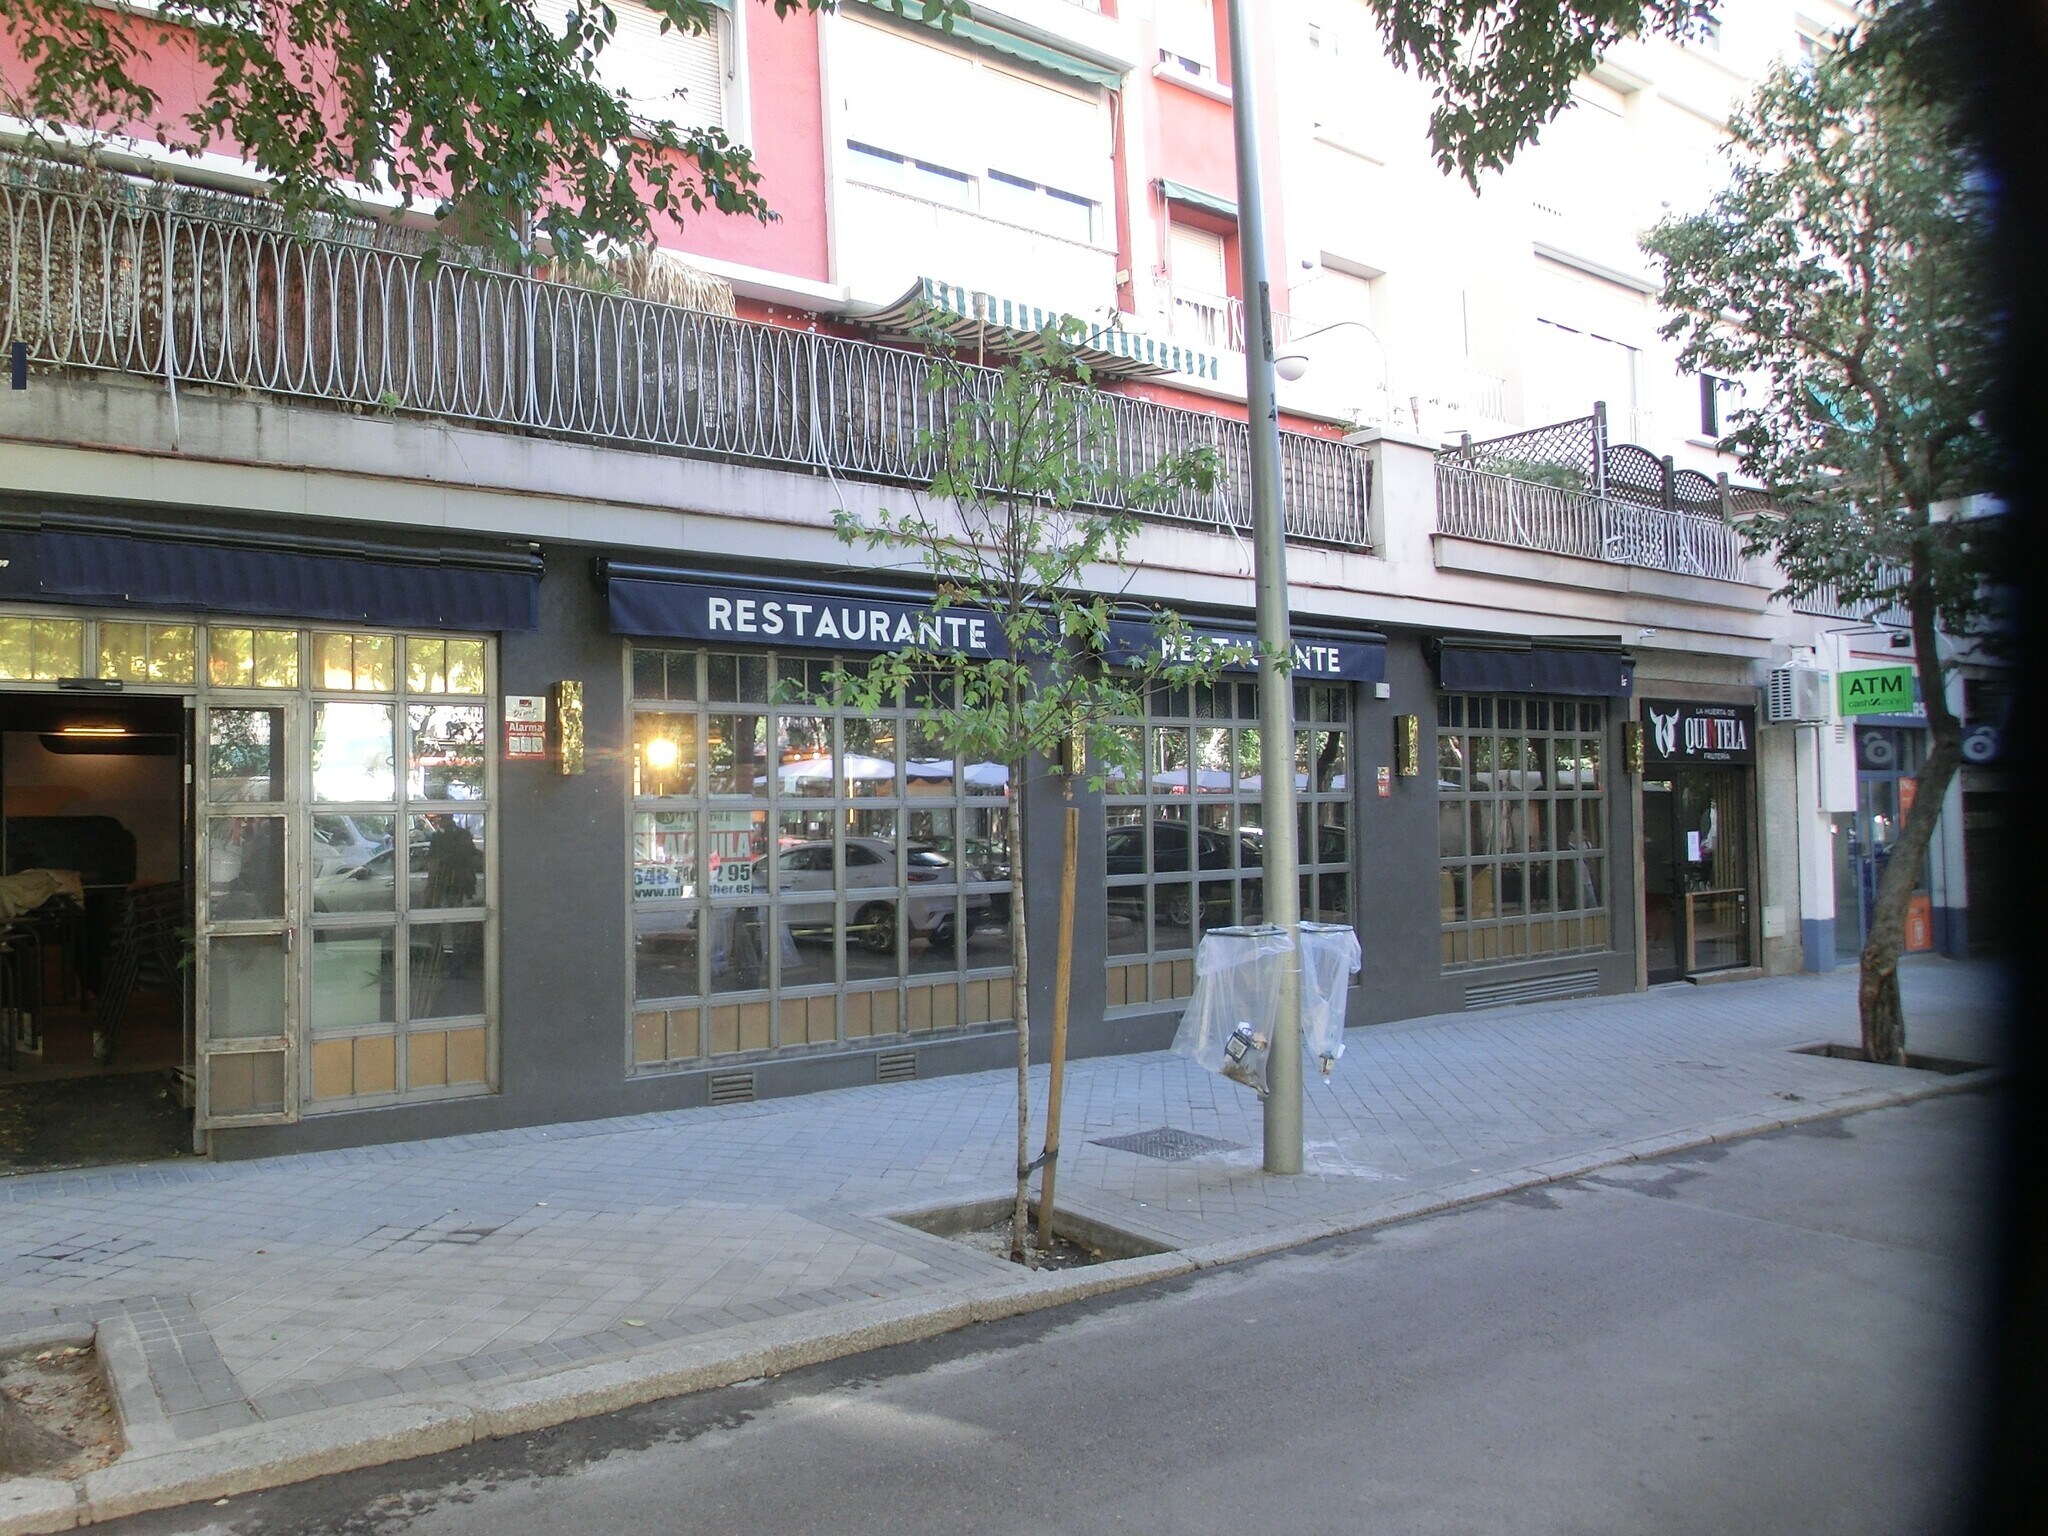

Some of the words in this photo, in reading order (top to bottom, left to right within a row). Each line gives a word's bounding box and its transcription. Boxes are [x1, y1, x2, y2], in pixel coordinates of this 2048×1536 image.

[708, 597, 987, 649] RESTAURANTE
[1161, 635, 1341, 673] RESTNTE
[1849, 675, 1903, 696] ATM
[509, 722, 543, 732] Alarma
[1684, 717, 1747, 755] QUINTELA
[727, 864, 751, 882] 95
